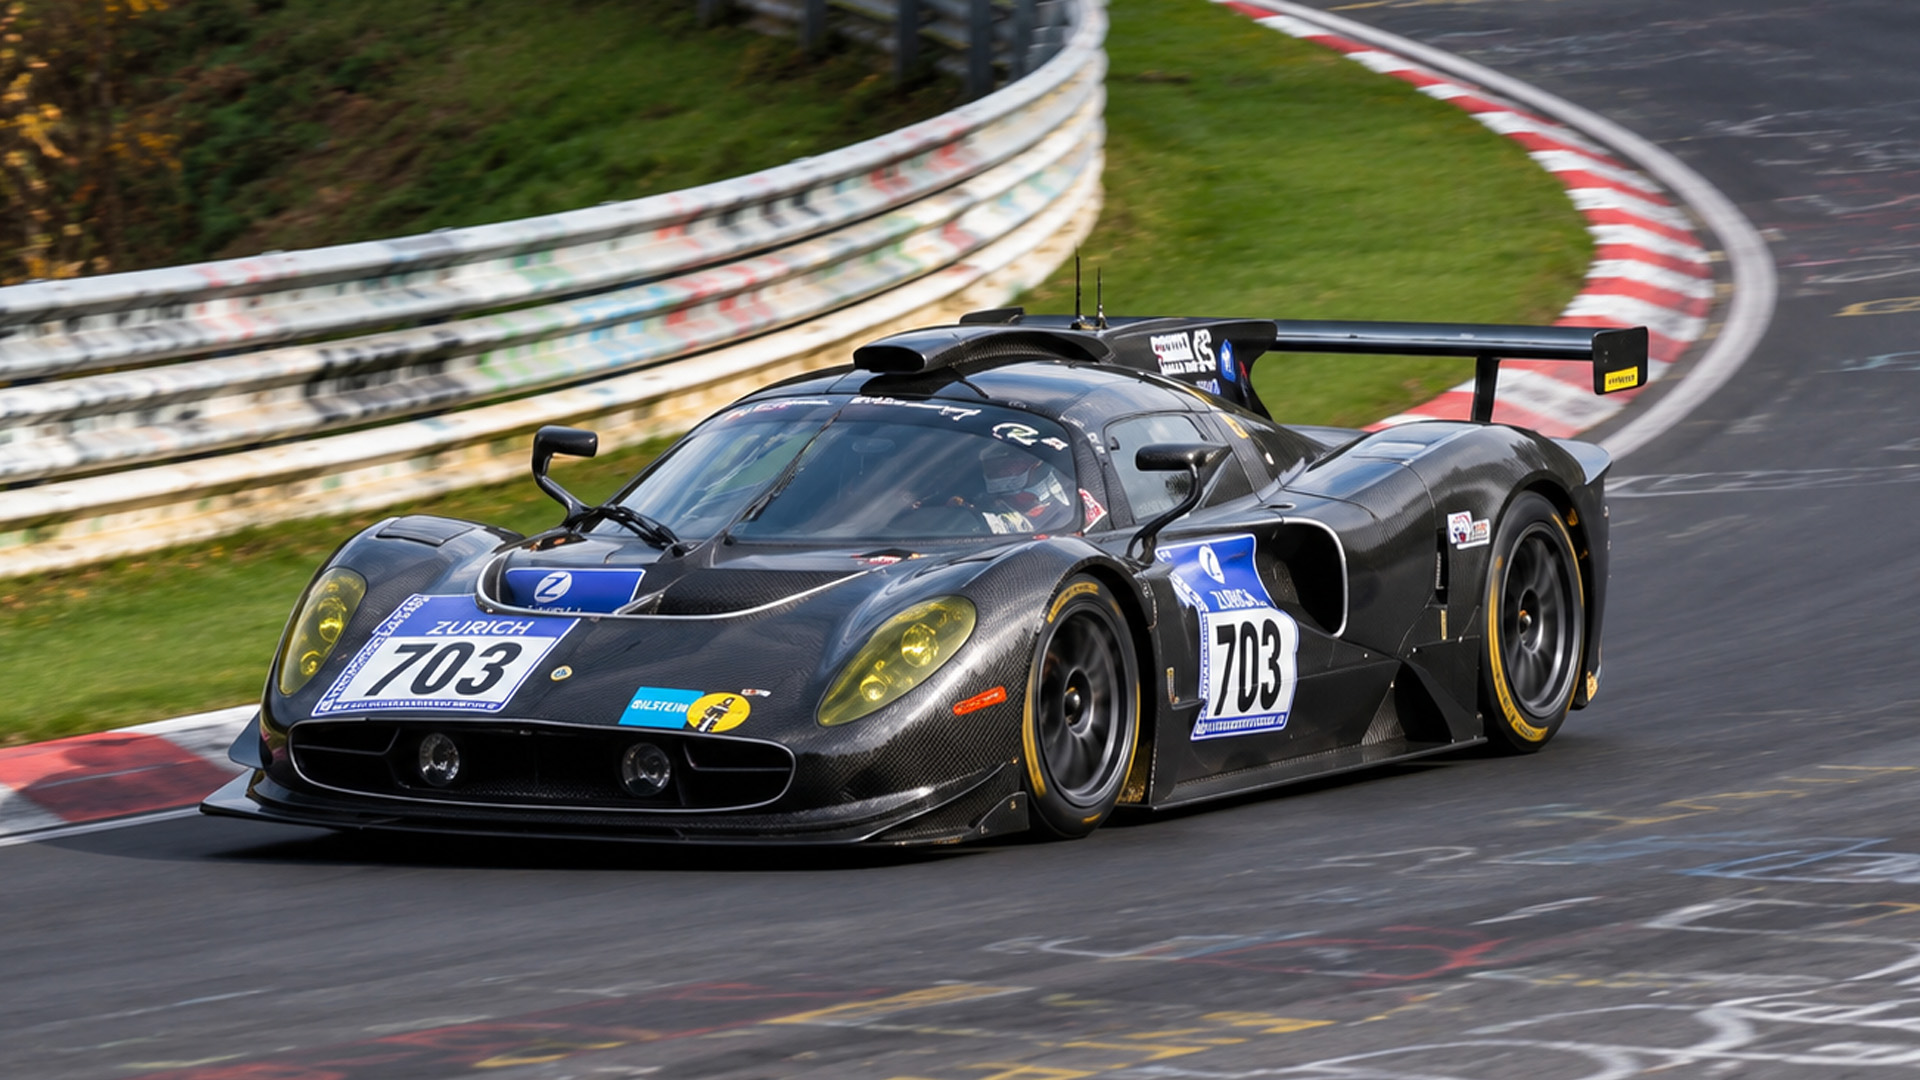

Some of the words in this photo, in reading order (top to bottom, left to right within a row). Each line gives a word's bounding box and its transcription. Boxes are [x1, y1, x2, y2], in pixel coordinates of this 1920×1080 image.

[425, 620, 535, 635] ZURICH
[364, 641, 523, 697] 703
[1214, 618, 1281, 717] 703
[631, 699, 689, 713] BILSTEIN
